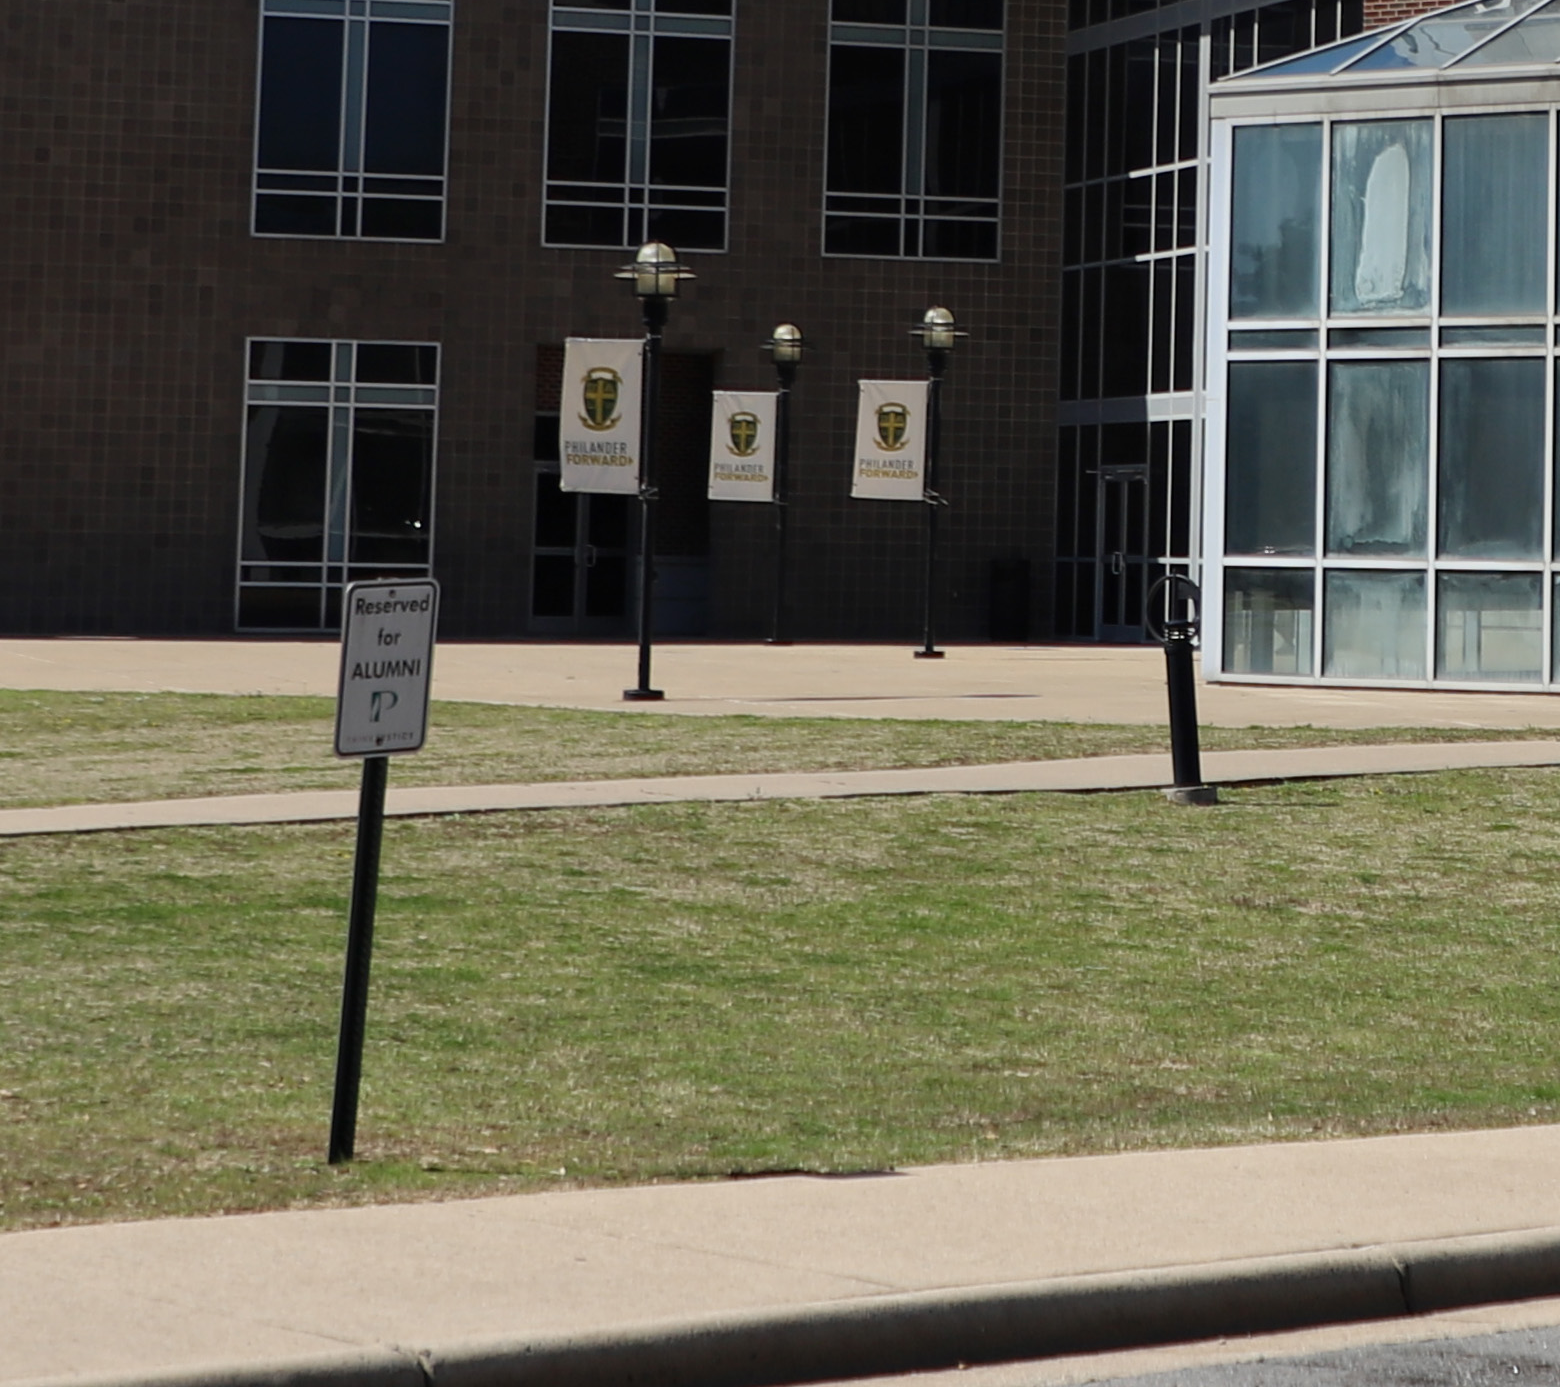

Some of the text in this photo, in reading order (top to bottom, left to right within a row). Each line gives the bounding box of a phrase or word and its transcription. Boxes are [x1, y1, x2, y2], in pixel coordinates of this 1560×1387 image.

[564, 440, 628, 455] PHILANDER
[566, 454, 629, 467] FORWARD
[859, 458, 915, 470] PHILANDER
[859, 468, 915, 479] FORWARD
[355, 593, 430, 616] Reserved
[377, 627, 402, 647] for
[351, 658, 421, 681] ALUMNI
